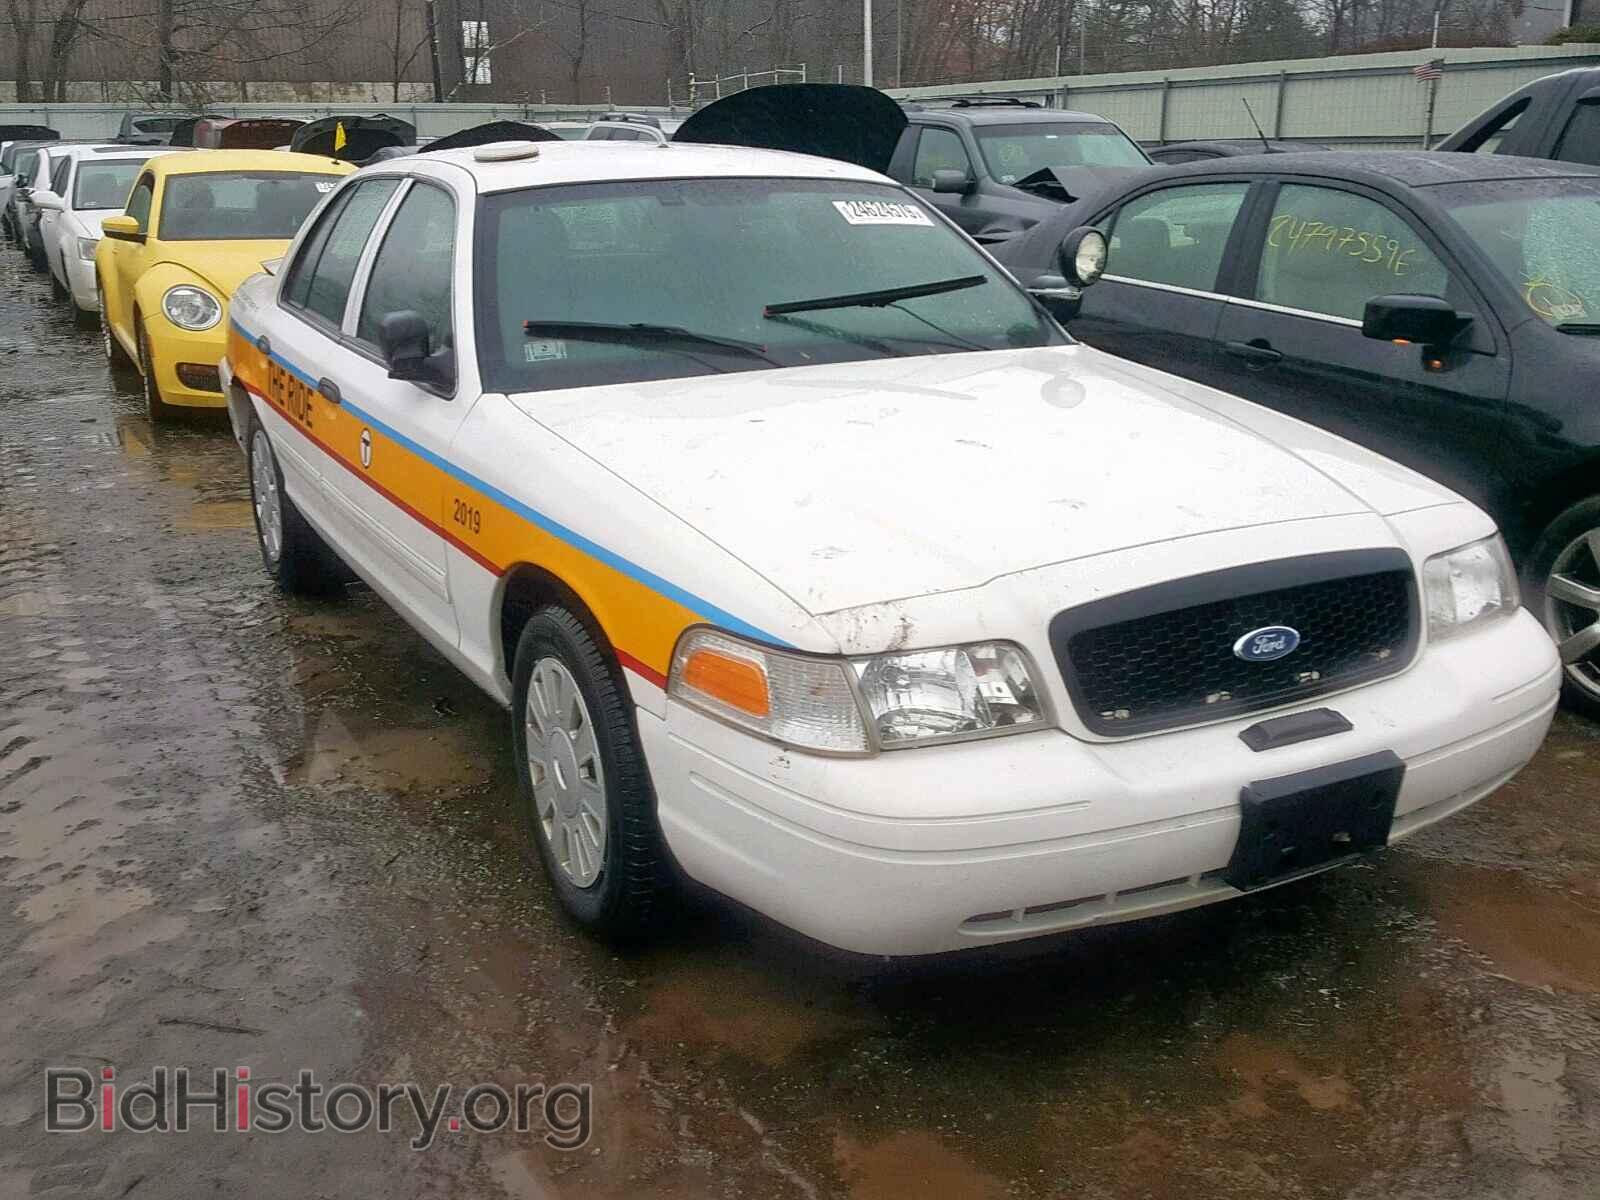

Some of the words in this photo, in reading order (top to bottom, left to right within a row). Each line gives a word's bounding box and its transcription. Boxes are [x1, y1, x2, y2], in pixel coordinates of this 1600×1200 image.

[268, 358, 285, 406] THE
[288, 373, 312, 429] RIDE
[454, 498, 481, 535] 2019
[1252, 633, 1285, 655] Ford
